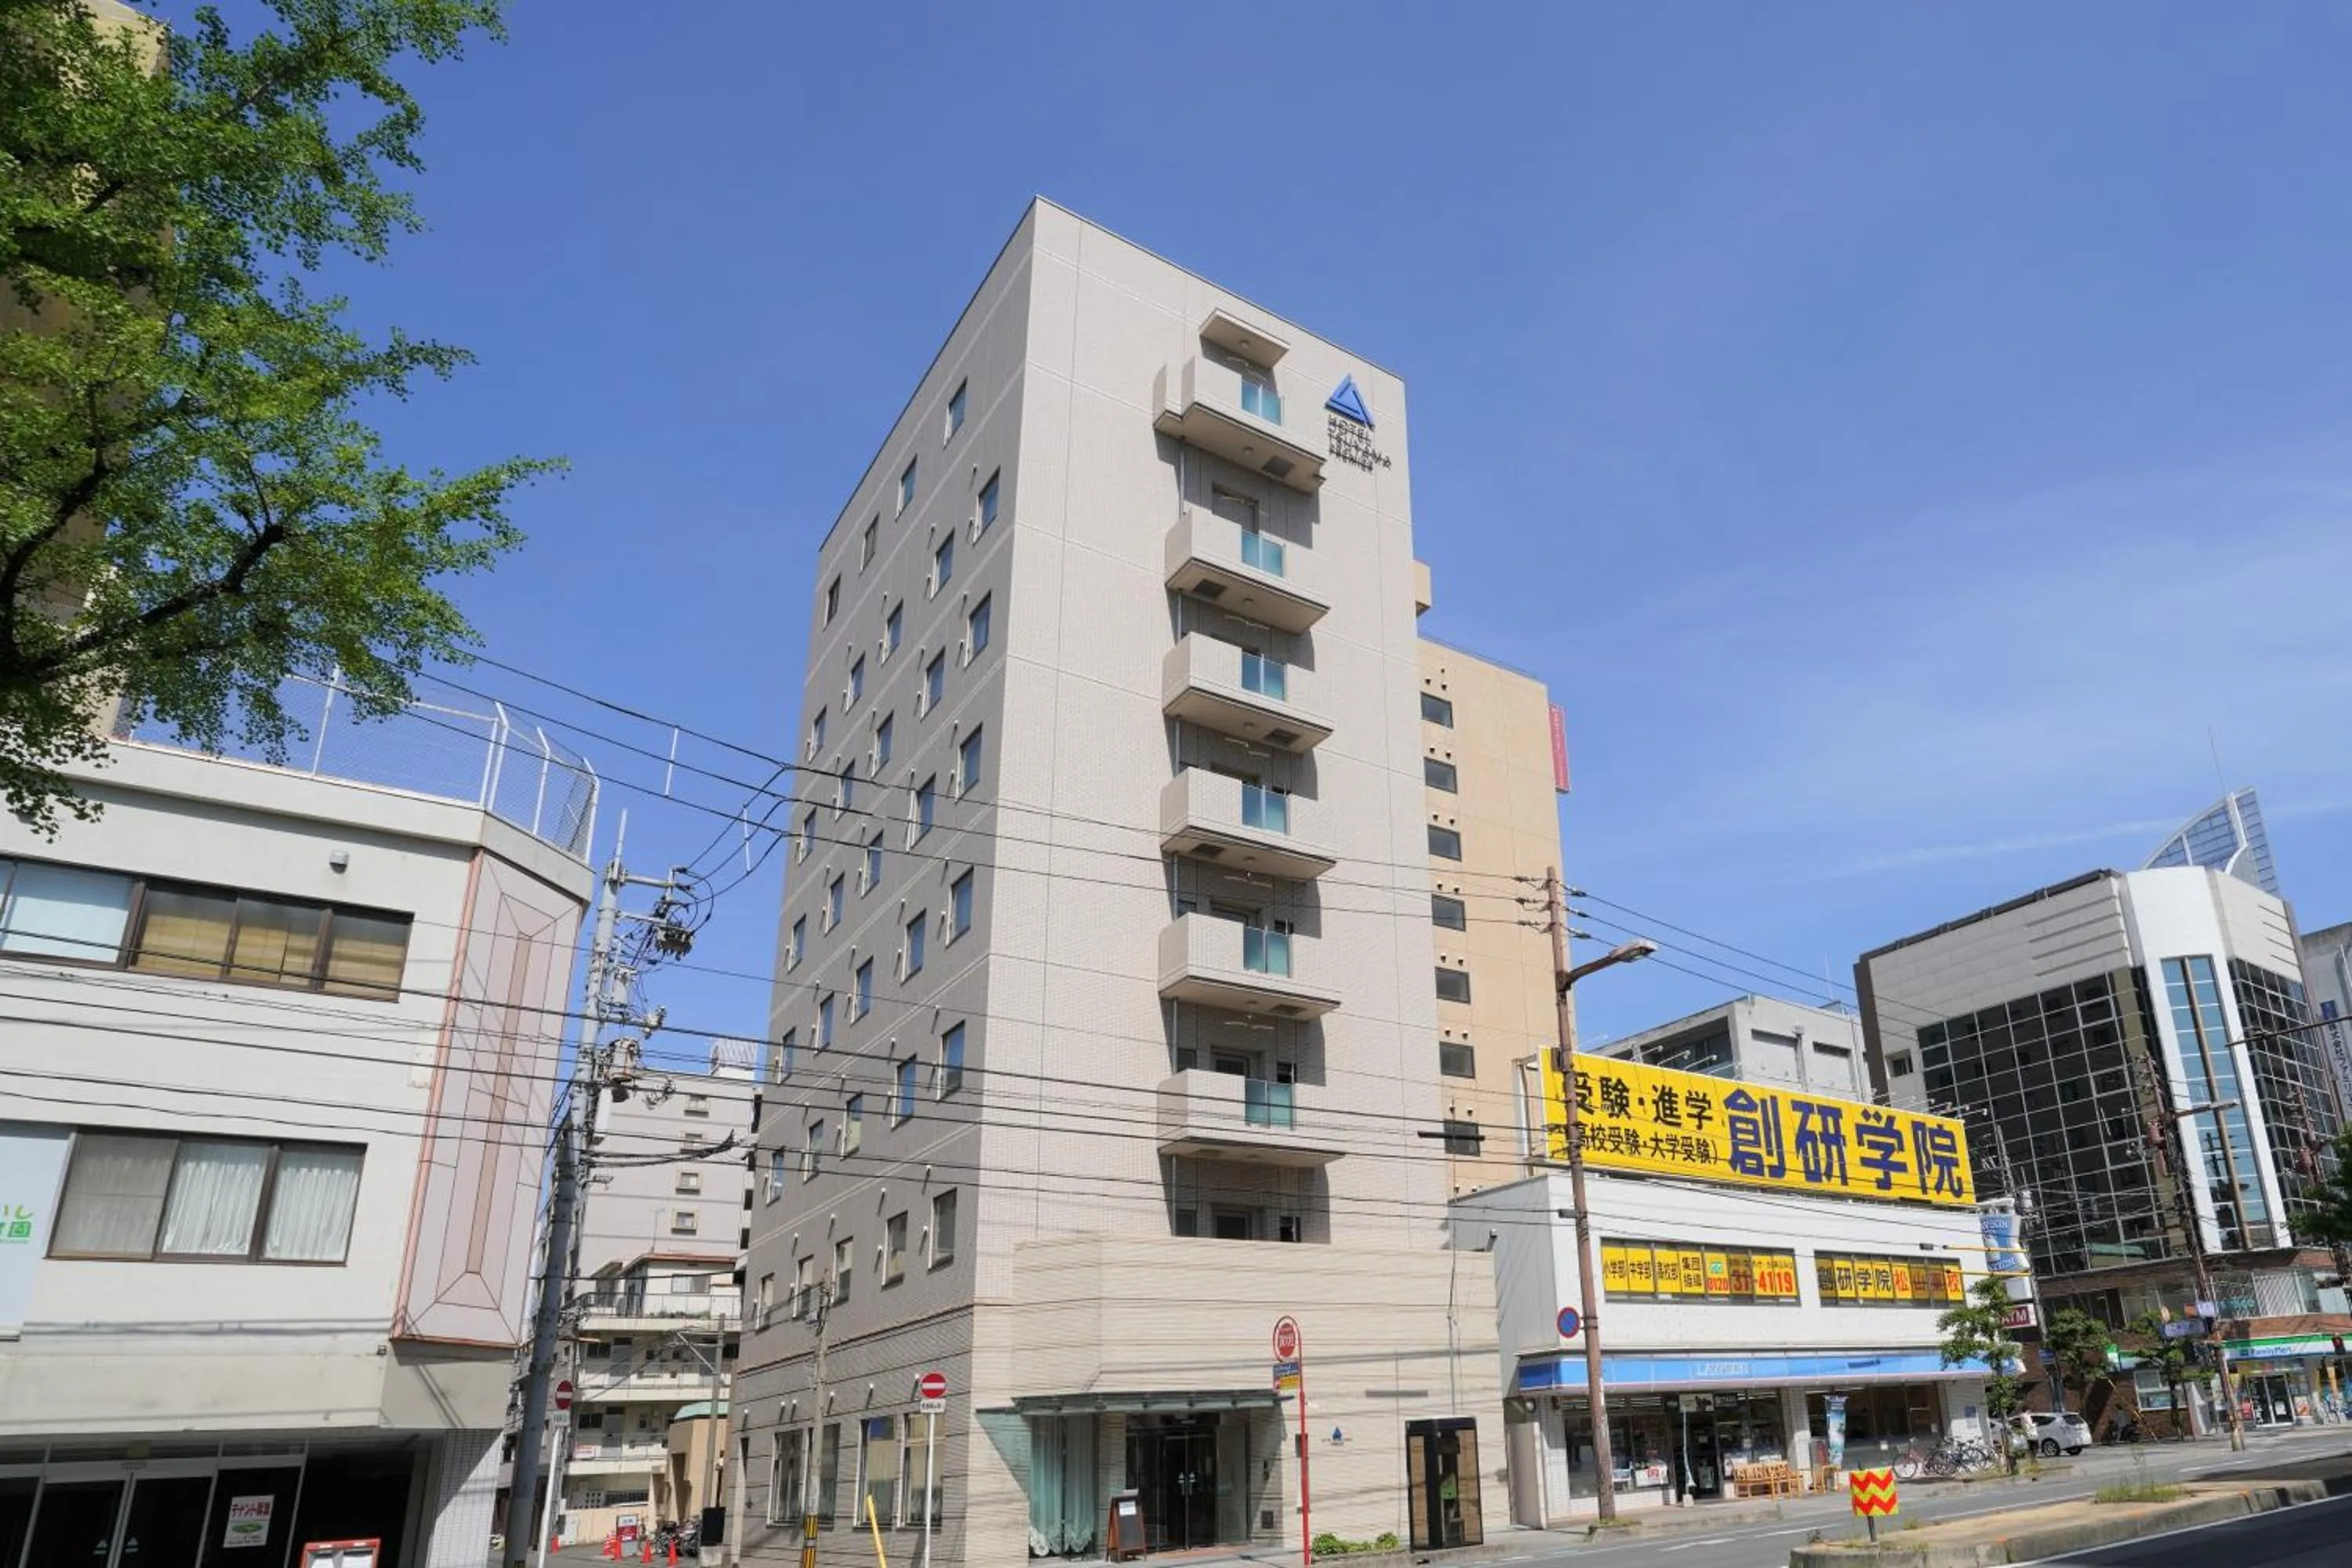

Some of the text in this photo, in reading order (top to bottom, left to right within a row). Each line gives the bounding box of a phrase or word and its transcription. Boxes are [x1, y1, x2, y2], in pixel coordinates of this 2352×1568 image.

[1563, 1070, 1713, 1131] 受験・進学
[1725, 1088, 1964, 1198] 創研学院
[2002, 1308, 2027, 1324] ATM
